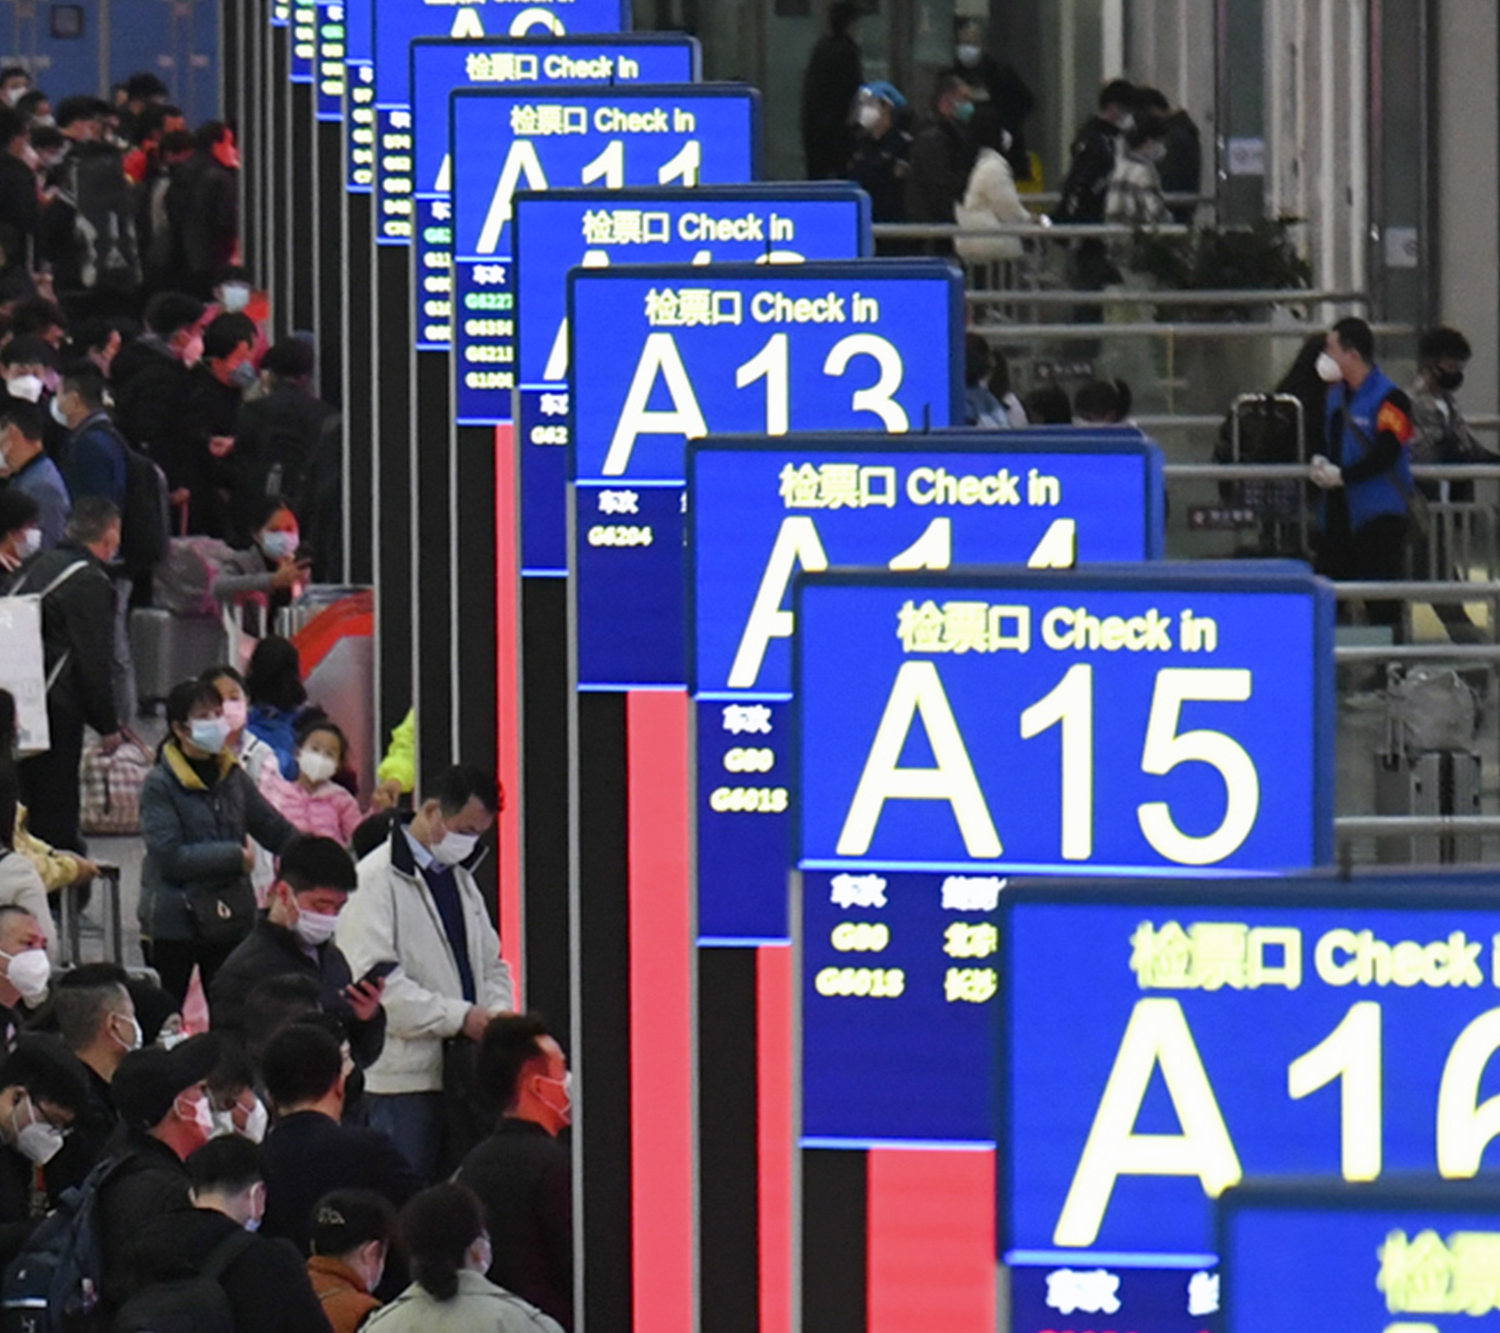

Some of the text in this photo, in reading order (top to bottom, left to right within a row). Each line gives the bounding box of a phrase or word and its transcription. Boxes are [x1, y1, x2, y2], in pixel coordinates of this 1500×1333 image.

[544, 55, 613, 78] Check
[618, 56, 638, 78] in
[511, 105, 695, 135] 检票口 Check in
[583, 210, 793, 244] 检票口 Check in
[645, 288, 878, 326] 检票口 Check in
[603, 333, 908, 475] A13
[779, 463, 1059, 509] 检票口 Check in
[897, 600, 1216, 653] 检票口 Check in
[836, 661, 1259, 864] A15
[711, 788, 787, 812] G6018
[832, 923, 888, 951] G80
[1130, 921, 1483, 990] 检票口 Check
[816, 968, 904, 997] G6018
